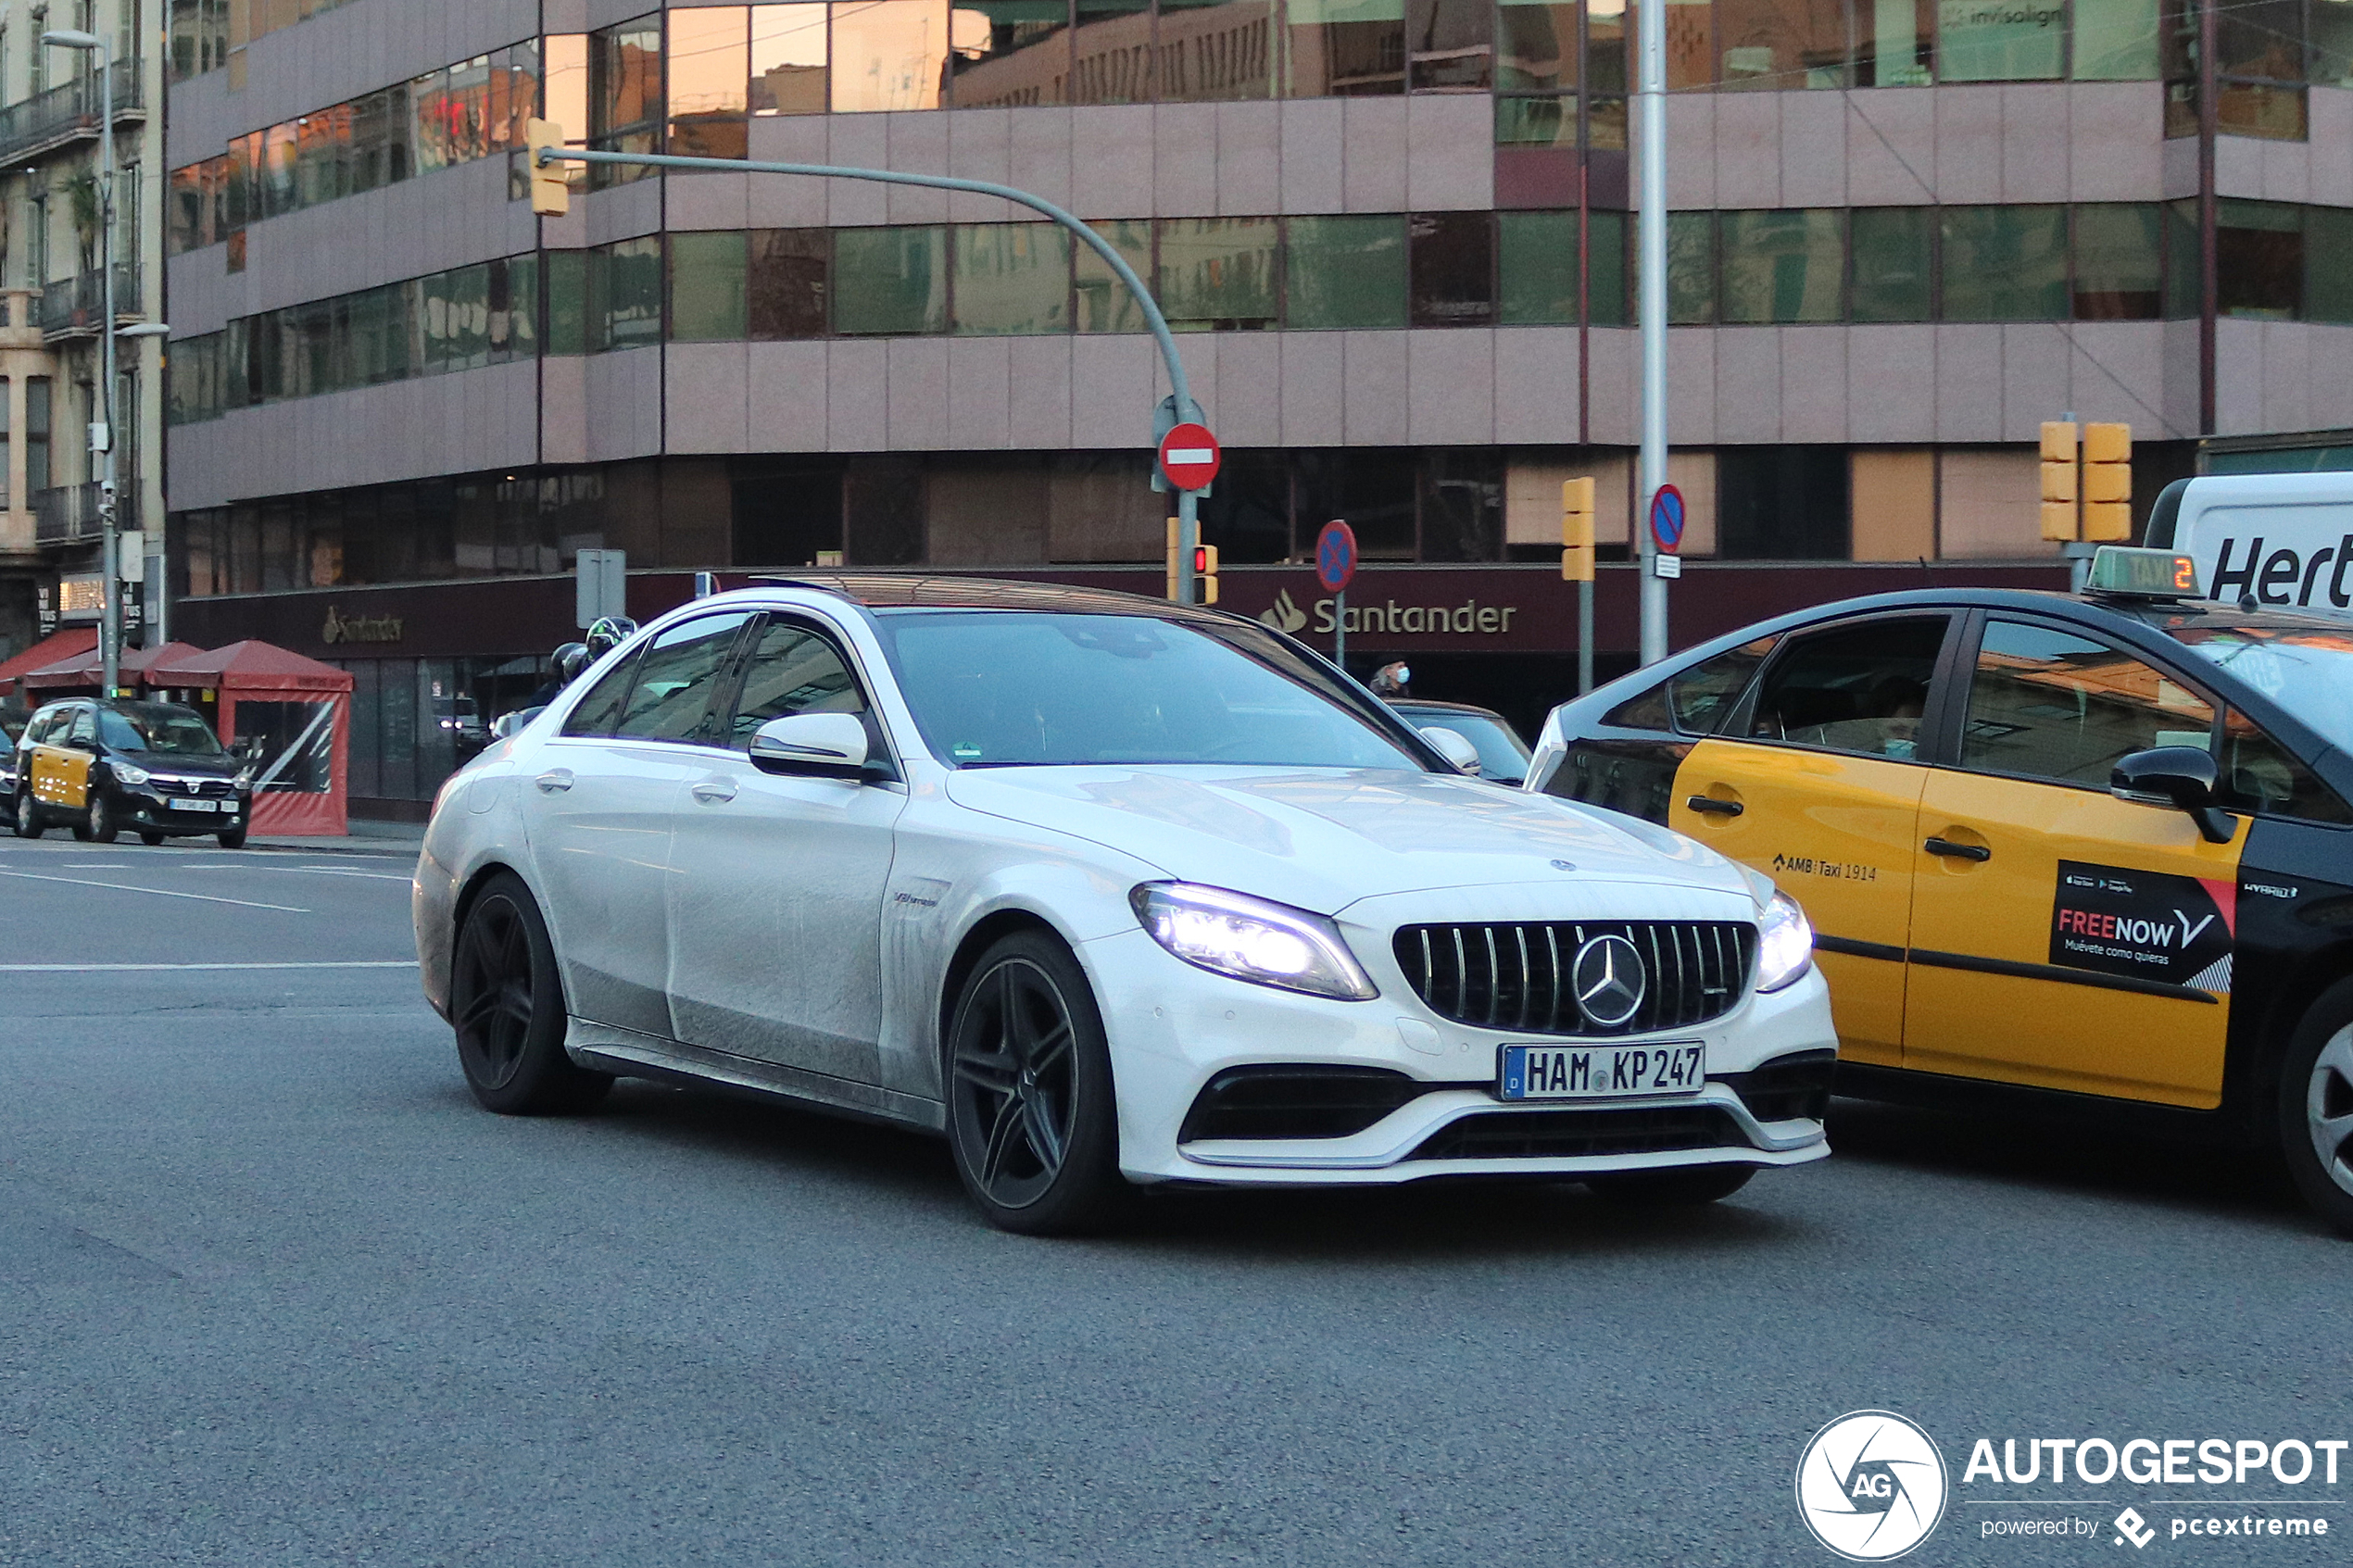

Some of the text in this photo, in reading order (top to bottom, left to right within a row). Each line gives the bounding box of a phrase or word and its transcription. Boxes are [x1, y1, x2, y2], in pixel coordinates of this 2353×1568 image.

[1970, 5, 2063, 27] invisalign
[2132, 556, 2192, 588] TAXI 2
[1314, 598, 1516, 633] Santander
[1787, 858, 1876, 882] AMB Taxi 1914
[2065, 938, 2169, 965] Muévete como quieras
[1510, 1078, 1518, 1089] D
[1529, 1052, 1591, 1092] HAM
